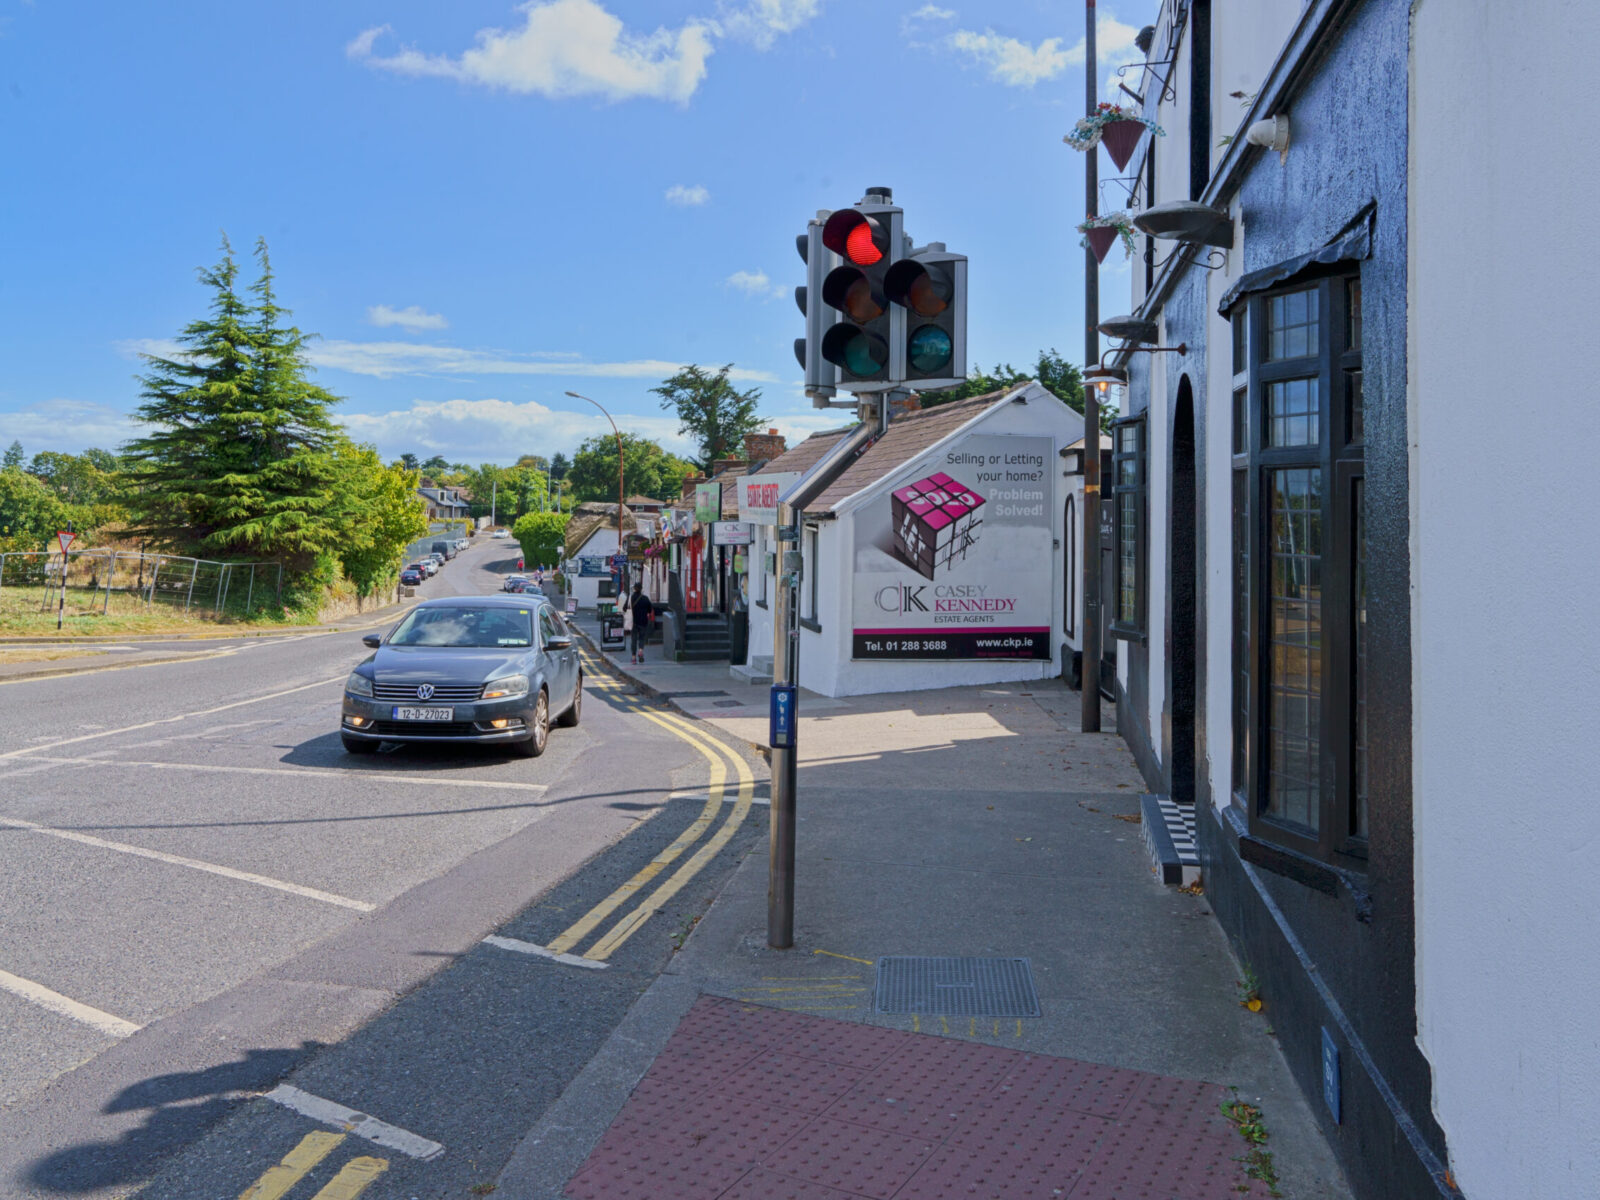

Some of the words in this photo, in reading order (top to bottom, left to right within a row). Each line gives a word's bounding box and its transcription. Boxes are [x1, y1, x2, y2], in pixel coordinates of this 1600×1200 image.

[947, 453, 985, 467] Selling
[988, 454, 1001, 465] or
[1004, 453, 1043, 467] Letting
[976, 471, 1002, 483] your
[1005, 470, 1044, 481] home?
[747, 484, 761, 508] ESTATE
[761, 483, 779, 508] AGENTS
[906, 490, 976, 507] SOLD
[989, 488, 1044, 500] Problem
[995, 504, 1044, 516] Solved!
[934, 585, 988, 598] CASEY
[935, 598, 1017, 612] KENNEDY
[934, 615, 961, 624] ESTATE
[963, 615, 995, 623] AGENTS
[865, 641, 884, 651] Tel.
[886, 641, 898, 651] 01
[901, 641, 920, 651] 288
[922, 640, 948, 650] 3688
[976, 637, 1034, 649] www.ckp.ie
[402, 709, 450, 720] 12-D-27023
